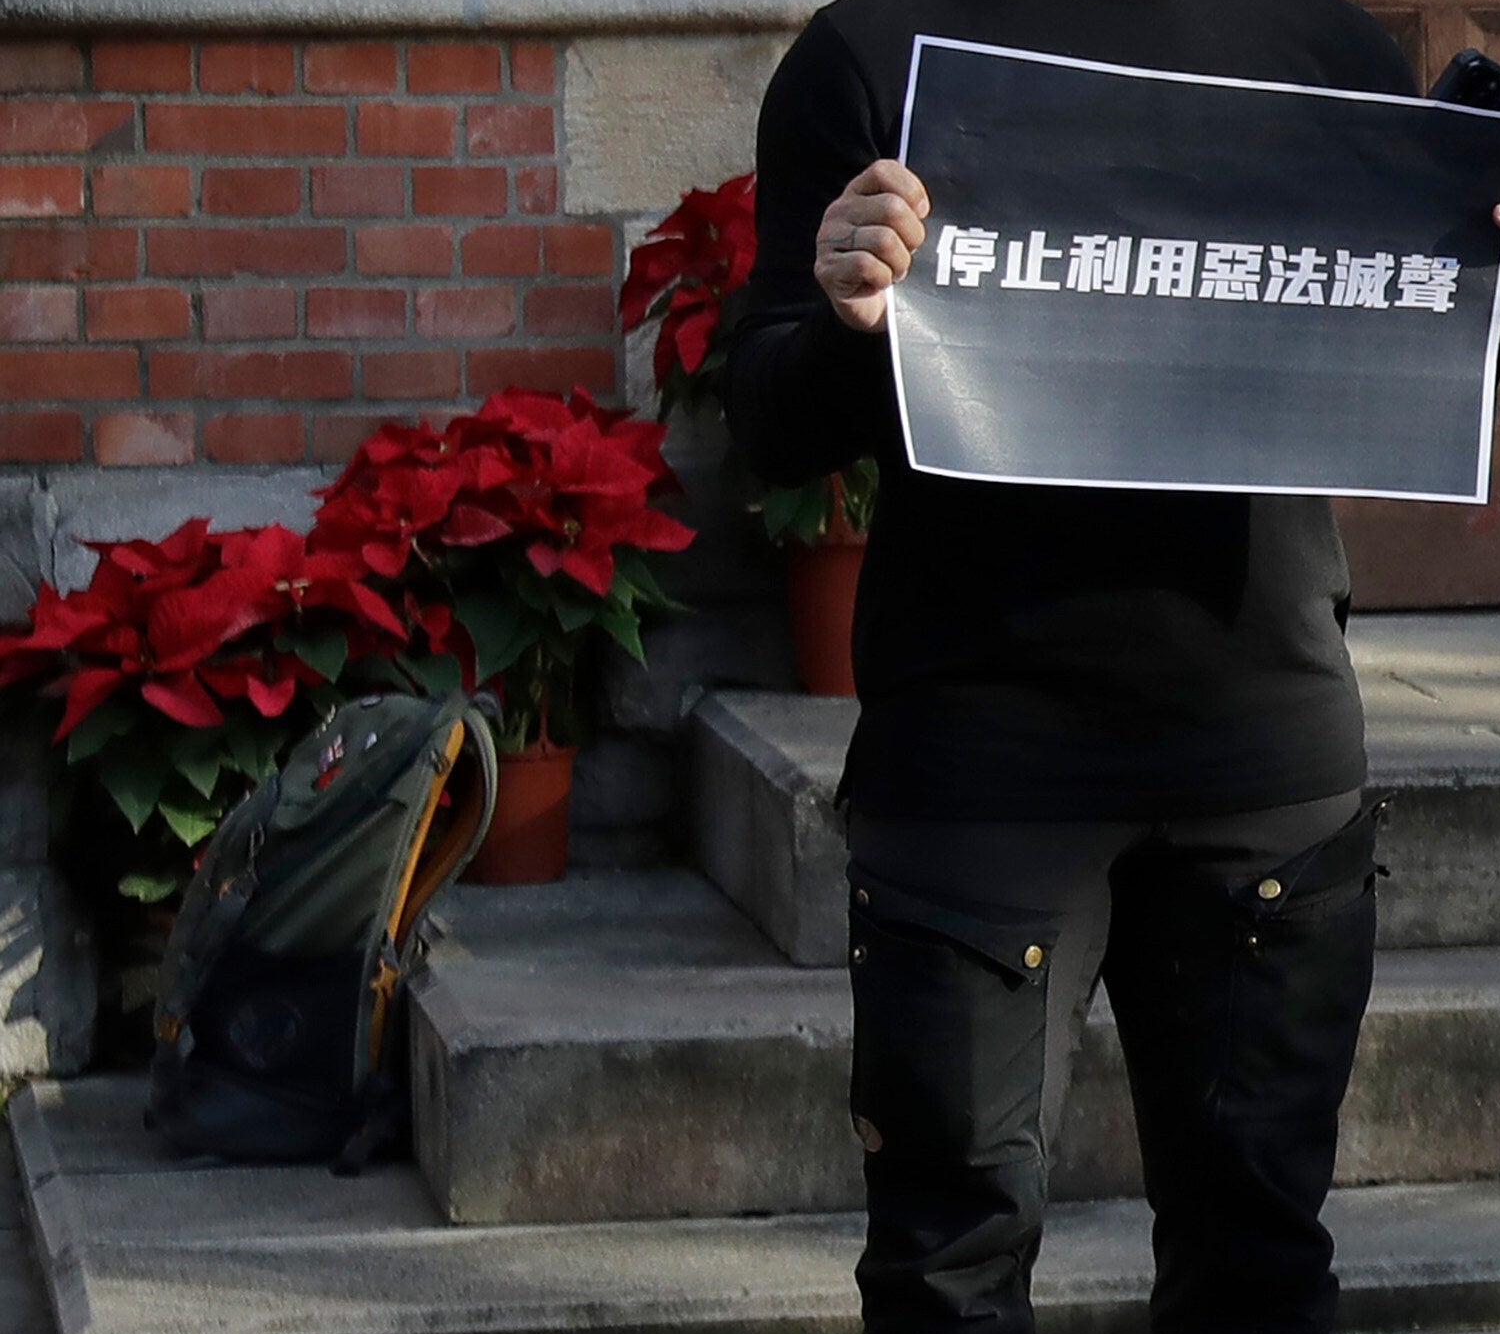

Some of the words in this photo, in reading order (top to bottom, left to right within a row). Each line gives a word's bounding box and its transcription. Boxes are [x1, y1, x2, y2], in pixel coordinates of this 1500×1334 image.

[935, 225, 1461, 313] 停止利用惡法滅聲
